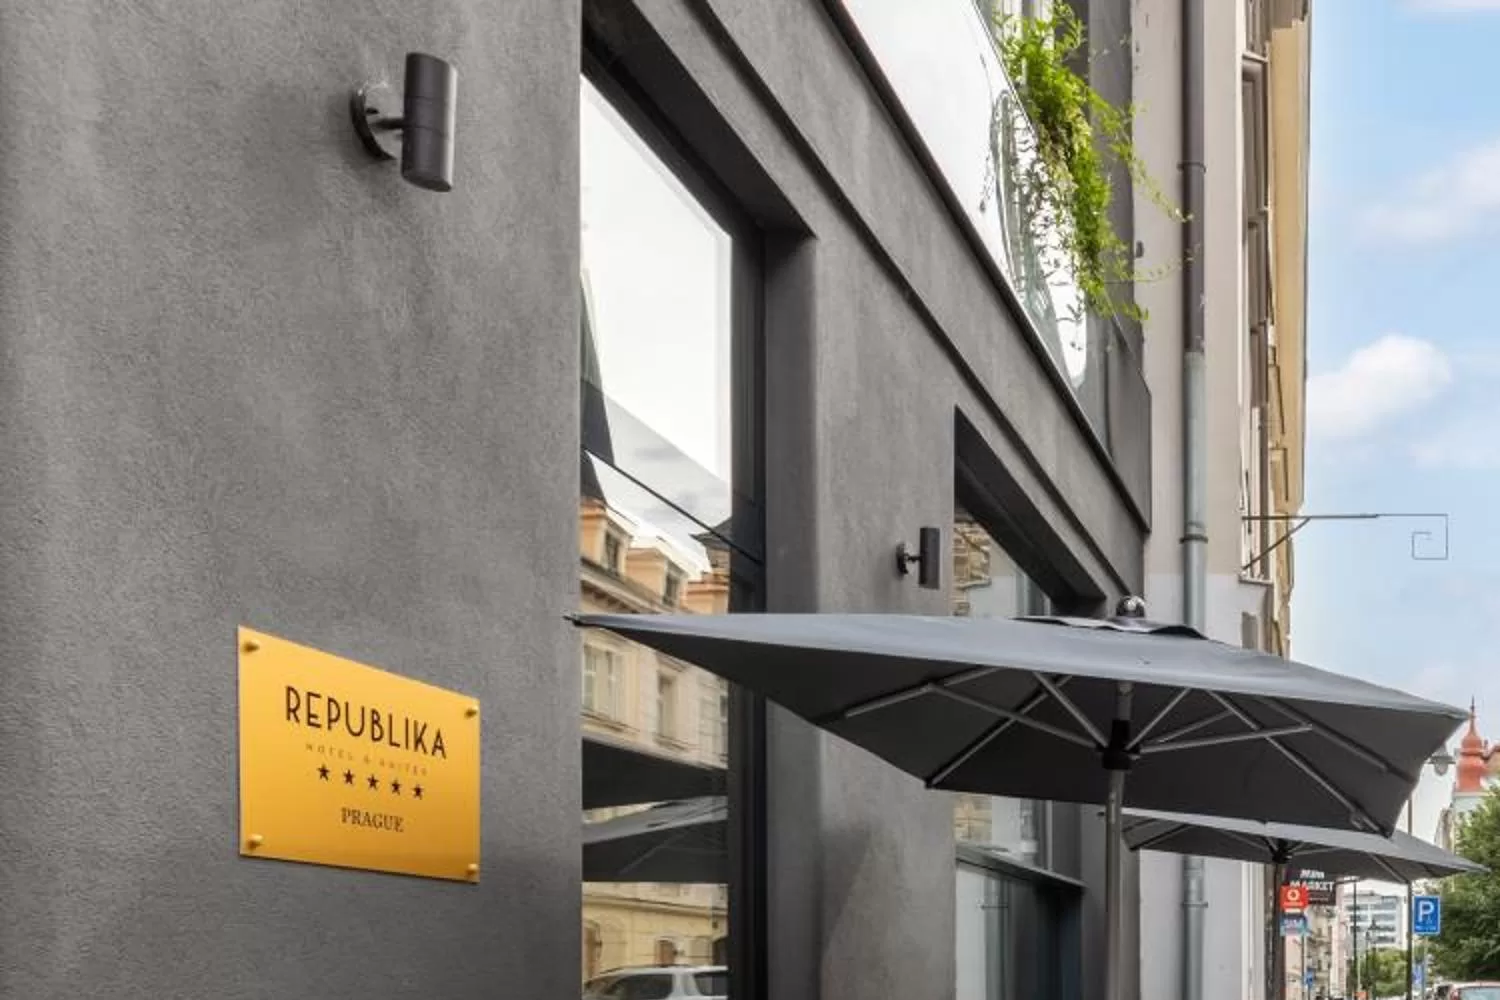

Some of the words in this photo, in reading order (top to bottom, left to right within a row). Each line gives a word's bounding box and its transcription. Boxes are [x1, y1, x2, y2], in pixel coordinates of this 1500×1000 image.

[285, 685, 447, 760] REPUBLIKA
[341, 806, 405, 833] PRAGUE
[1418, 901, 1435, 923] P
